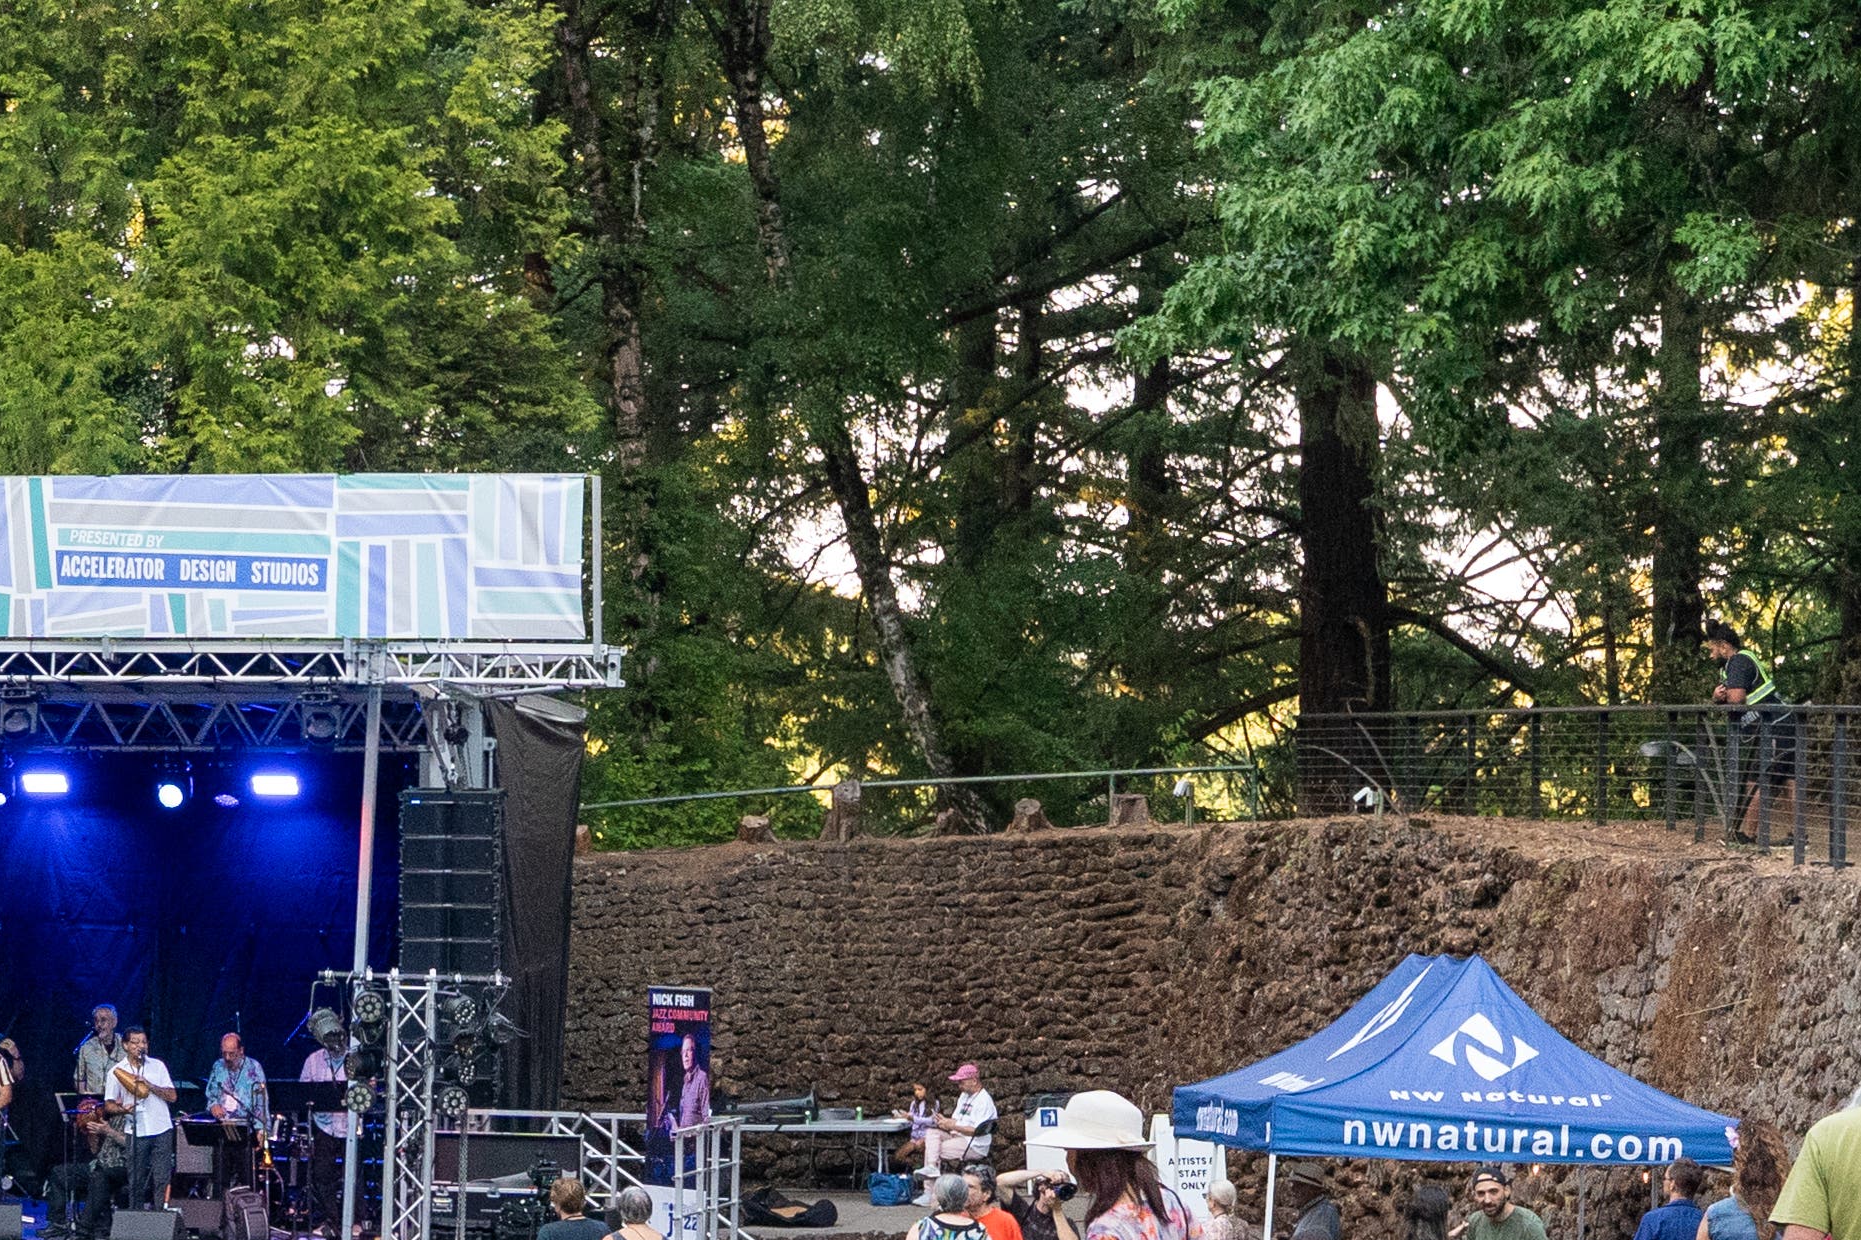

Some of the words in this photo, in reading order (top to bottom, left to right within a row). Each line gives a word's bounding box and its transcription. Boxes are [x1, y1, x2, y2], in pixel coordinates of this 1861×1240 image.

[69, 529, 144, 547] PRESENTED
[146, 534, 164, 548] BY
[61, 554, 165, 580] ACCELERATOR
[179, 558, 237, 583] DESIGN
[250, 561, 319, 586] STUDIOS
[652, 993, 674, 1006] NICK
[674, 994, 695, 1007] FISH
[1389, 1090, 1444, 1102] NW
[1343, 1117, 1684, 1161] nwnatural.com
[1178, 1169, 1207, 1178] STAFF
[1181, 1182, 1206, 1190] ONLY
